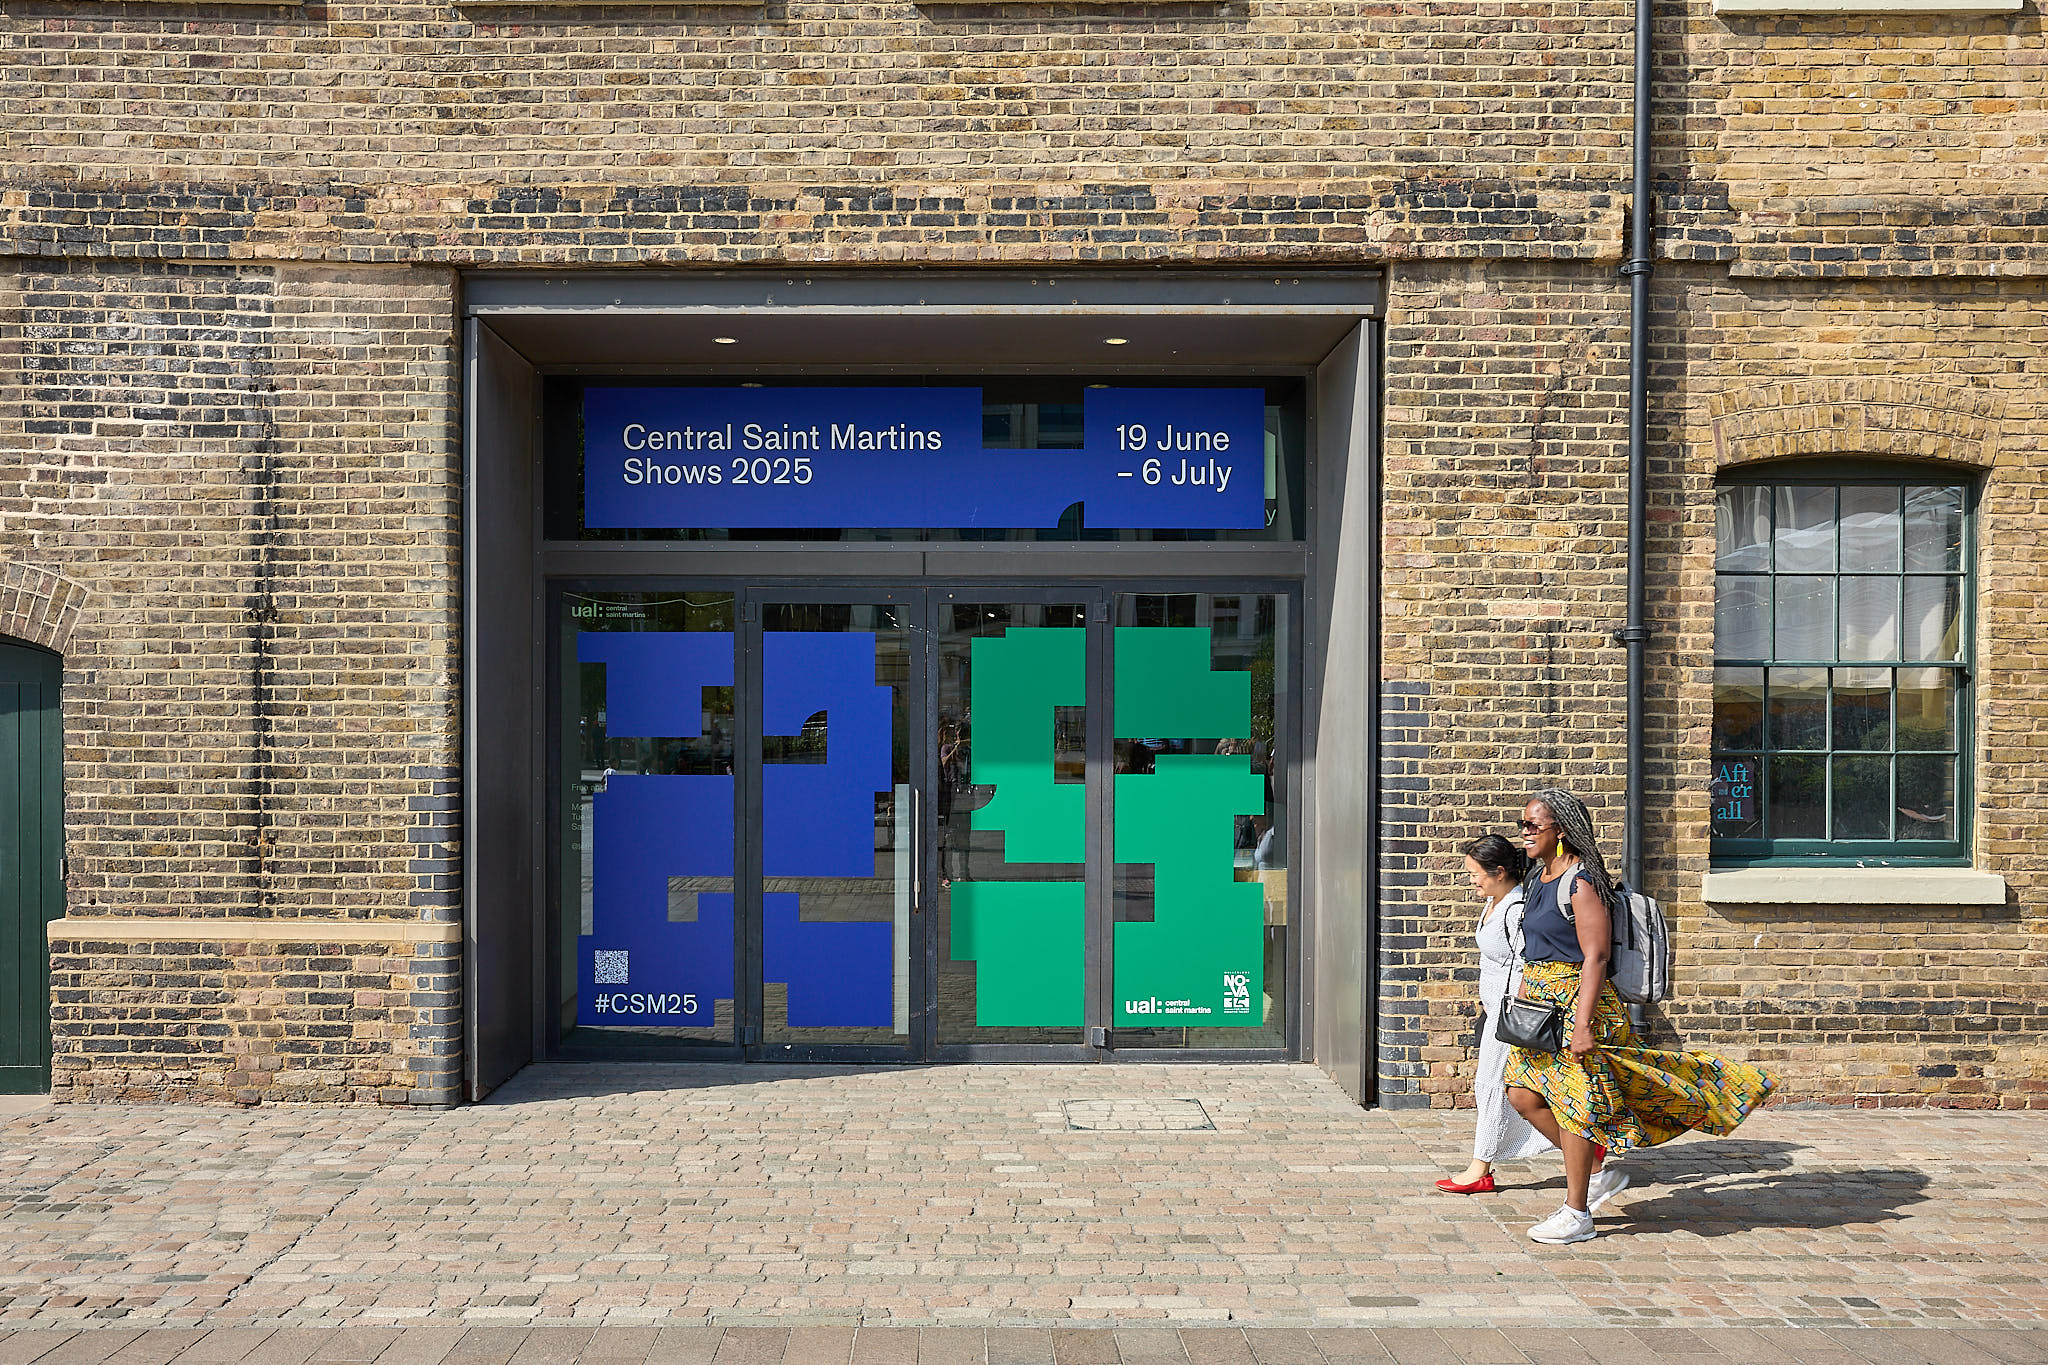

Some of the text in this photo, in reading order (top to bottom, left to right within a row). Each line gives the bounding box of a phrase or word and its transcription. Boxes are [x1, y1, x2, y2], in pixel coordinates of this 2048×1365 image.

[623, 423, 942, 450] Central Saint Martins
[1116, 424, 1230, 451] 19 June
[623, 458, 813, 484] Shows 2025
[1142, 458, 1162, 485] 6
[1171, 458, 1232, 492] July
[571, 602, 603, 618] ual:
[1717, 800, 1744, 820] all
[594, 993, 699, 1014] #CSM25
[1125, 996, 1163, 1014] ual:
[1165, 999, 1191, 1007] central
[1184, 1006, 1212, 1014] martins
